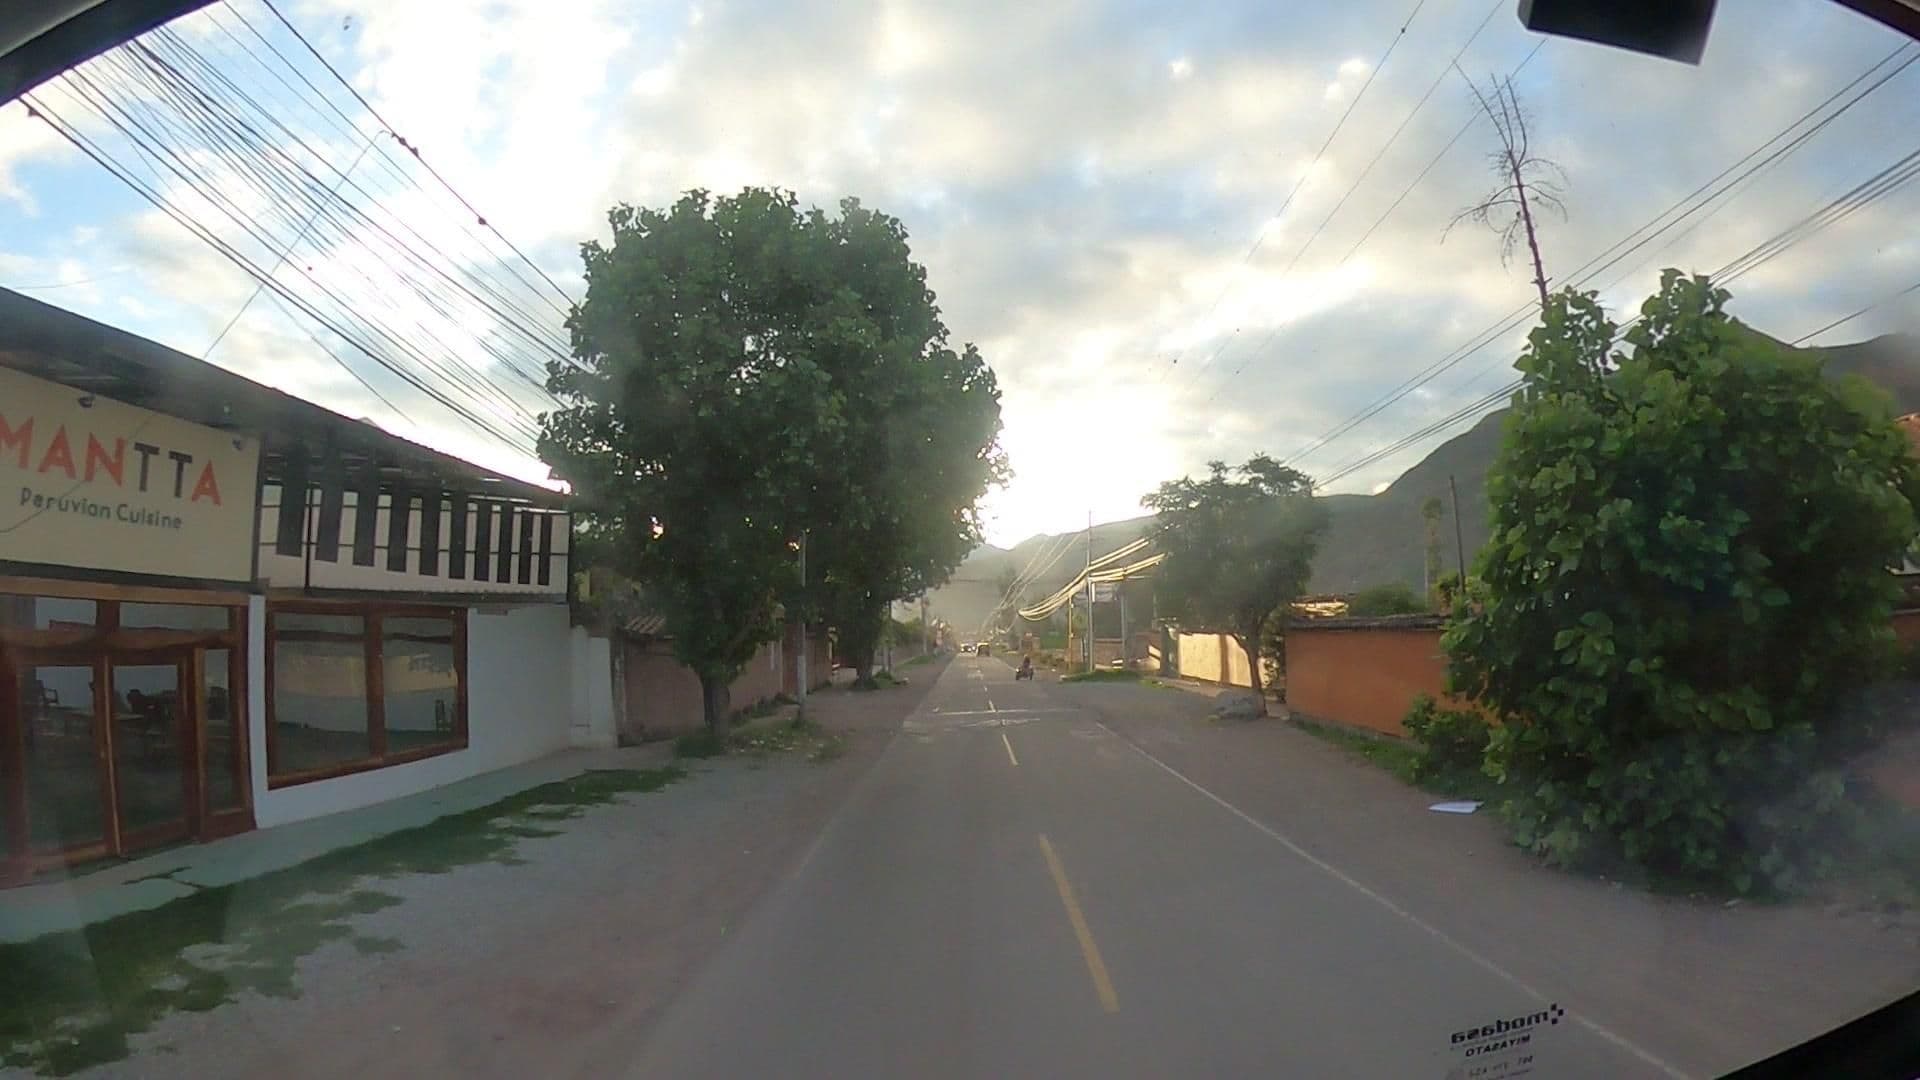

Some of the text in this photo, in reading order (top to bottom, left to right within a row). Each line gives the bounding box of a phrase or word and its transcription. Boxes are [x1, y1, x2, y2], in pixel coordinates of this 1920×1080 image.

[0, 412, 222, 507] MANTTA
[19, 487, 183, 530] Peruvian Cuisine
